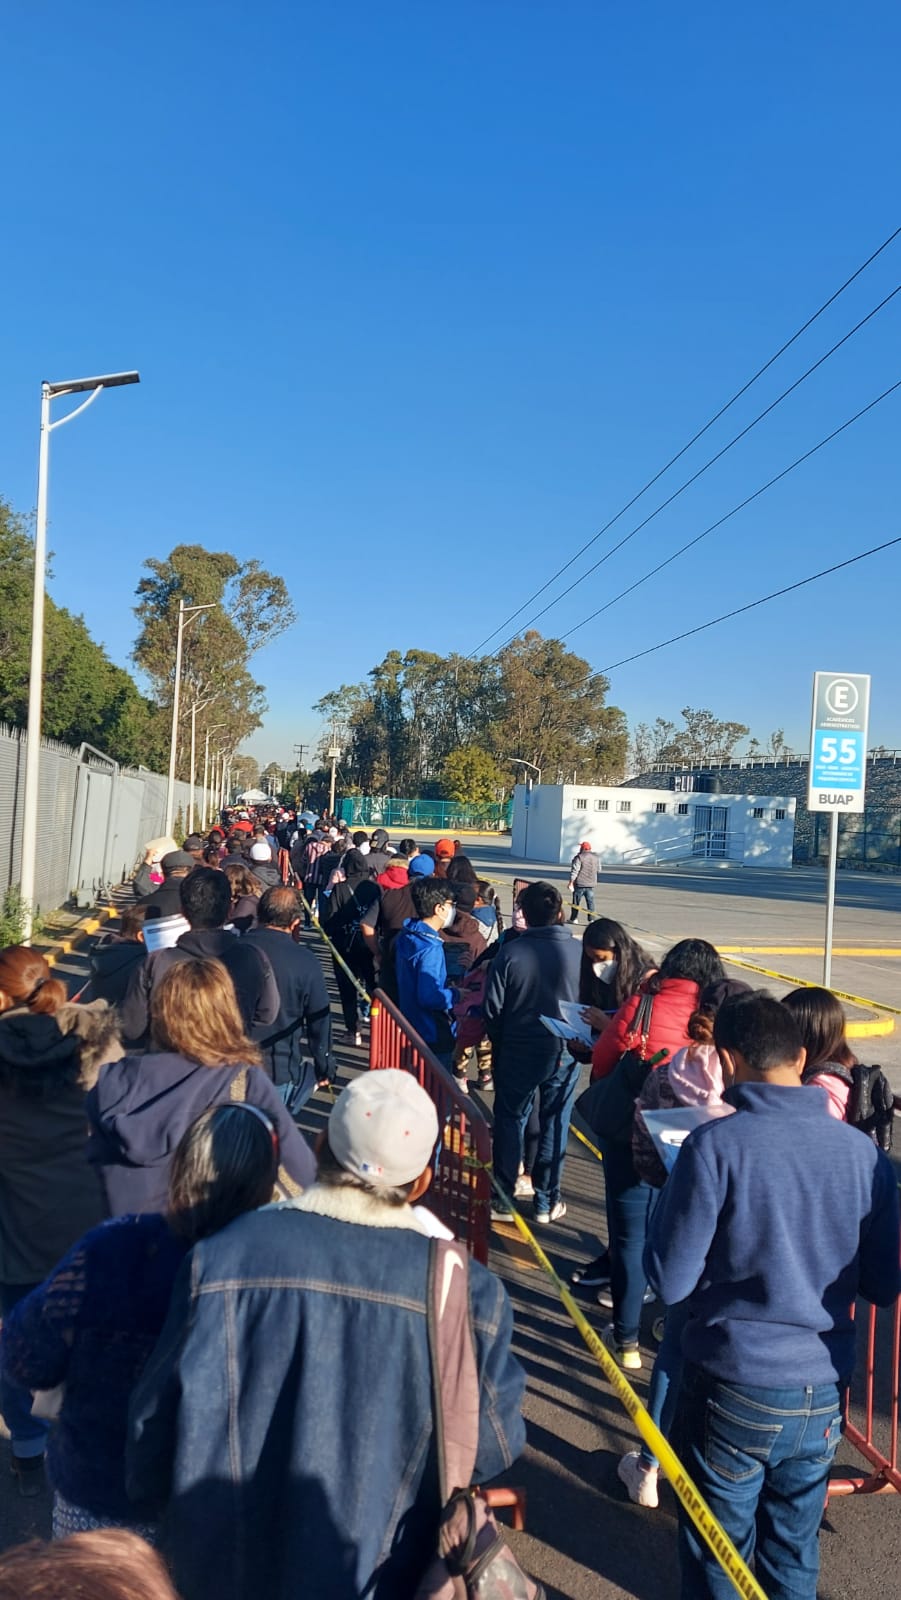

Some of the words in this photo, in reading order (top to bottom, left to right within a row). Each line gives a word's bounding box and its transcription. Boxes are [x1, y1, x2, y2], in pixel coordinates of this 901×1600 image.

[834, 686, 849, 708] E
[819, 737, 857, 765] 55
[818, 793, 854, 805] BUAP
